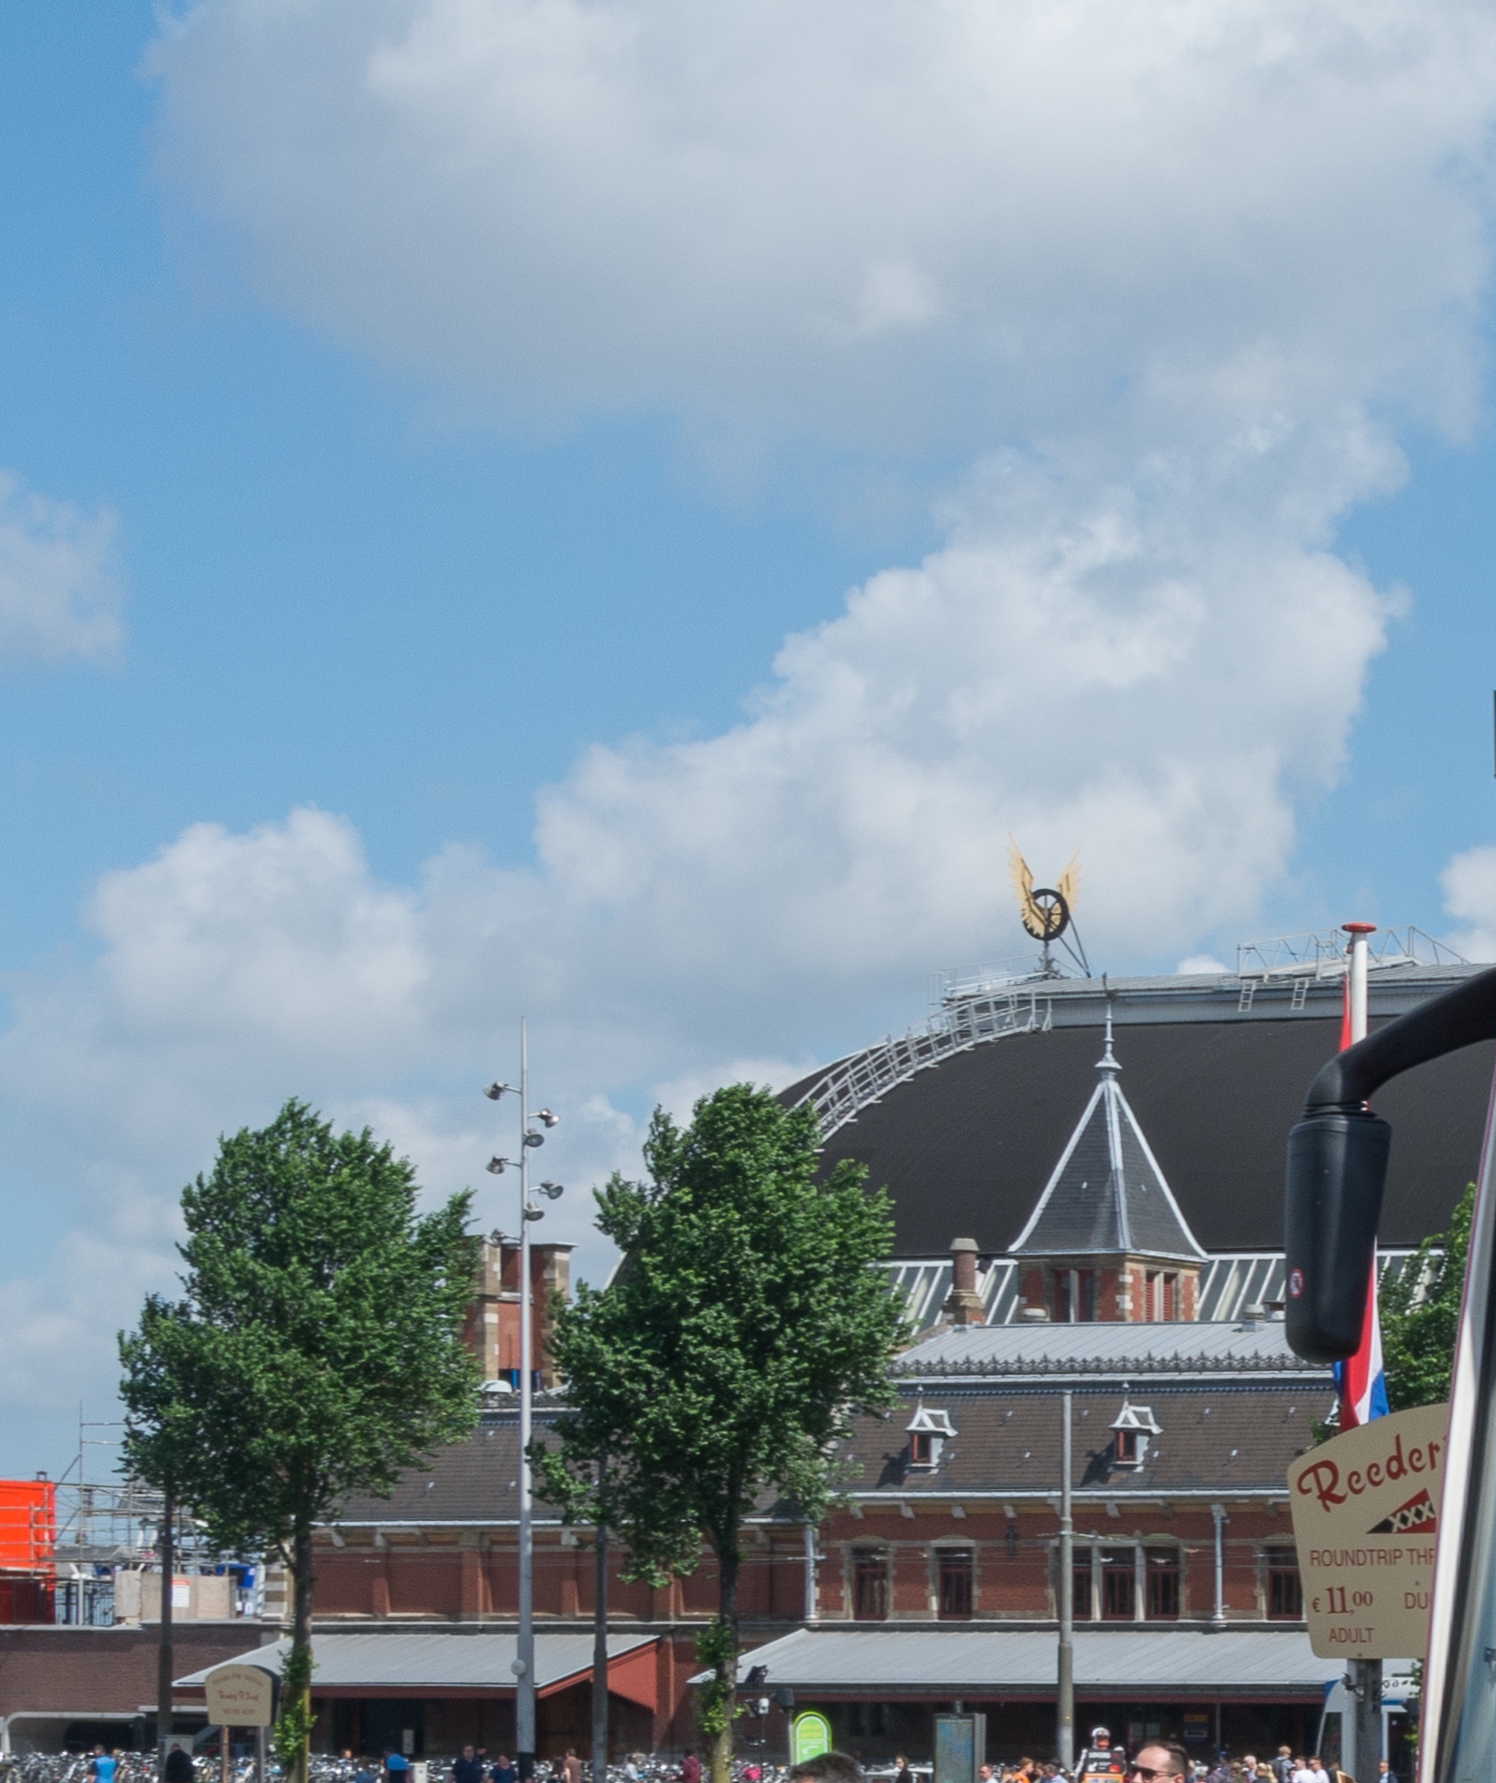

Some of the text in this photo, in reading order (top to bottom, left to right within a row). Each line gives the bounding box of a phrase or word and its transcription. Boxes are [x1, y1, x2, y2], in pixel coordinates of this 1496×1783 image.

[1310, 1548, 1403, 1567] ROUNDTRIP
[1312, 1598, 1321, 1614] €
[1325, 1586, 1374, 1615] 11,00
[1329, 1627, 1374, 1644] ADULT
